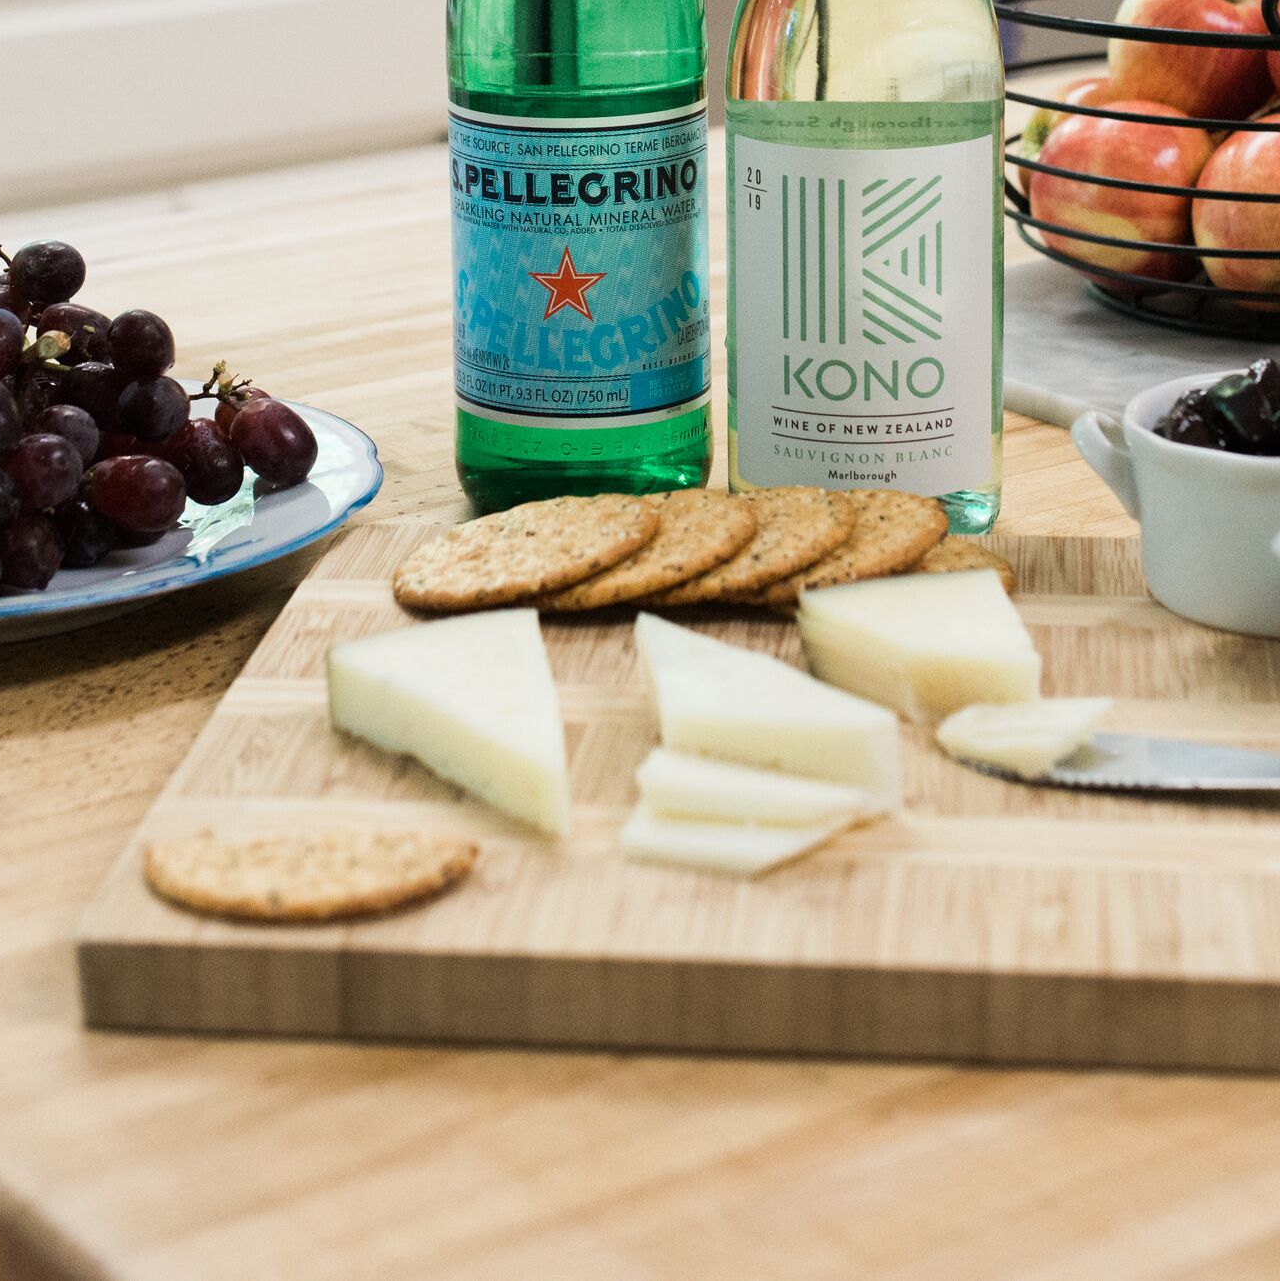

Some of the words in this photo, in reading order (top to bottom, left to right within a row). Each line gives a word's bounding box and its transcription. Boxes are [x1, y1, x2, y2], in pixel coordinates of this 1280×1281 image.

[473, 137, 514, 156] SOURCE,
[517, 143, 542, 157] SAN
[546, 143, 621, 157] PELLEGRINO
[624, 138, 659, 154] TERME
[452, 157, 697, 207] S.PELLEGRINO
[511, 210, 583, 227] NATURAL
[589, 208, 657, 226] MINERAL
[661, 198, 696, 218] WATER
[520, 225, 552, 234] NATURAL
[570, 226, 597, 235] ADDED
[605, 224, 628, 233] TOTAL
[642, 360, 663, 371] BEST
[783, 354, 945, 402] KONO
[475, 378, 487, 393] OZ
[500, 384, 514, 400] PT,
[516, 387, 532, 400] 9.3
[535, 388, 548, 402] FL
[551, 389, 574, 404] OZ)
[577, 390, 604, 405] (750
[606, 387, 629, 403] mL)
[773, 415, 810, 431] WINE
[816, 422, 836, 434] OF
[844, 424, 879, 435] NEW
[885, 417, 953, 435] ZEALAND
[773, 444, 885, 464] SAUVIGNON
[895, 445, 953, 463] BLANC
[827, 469, 897, 483] Marlborough
